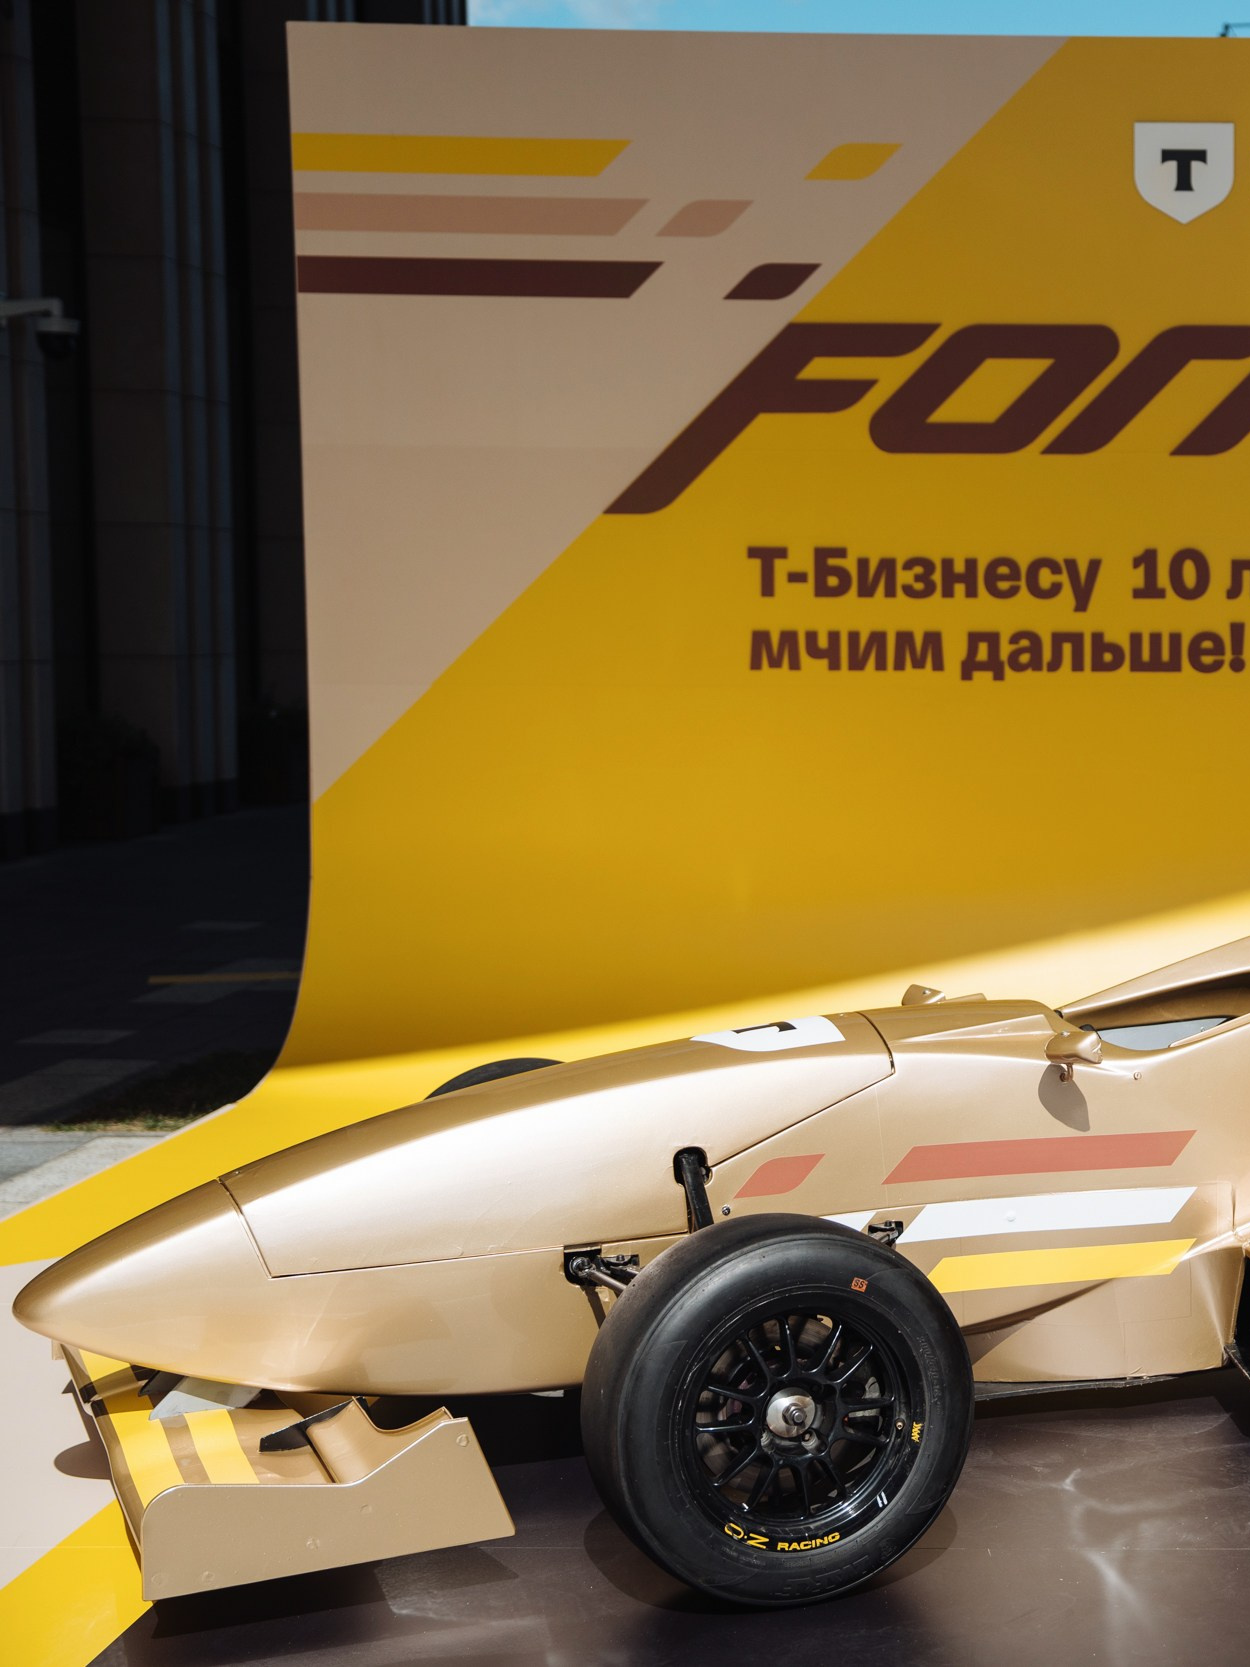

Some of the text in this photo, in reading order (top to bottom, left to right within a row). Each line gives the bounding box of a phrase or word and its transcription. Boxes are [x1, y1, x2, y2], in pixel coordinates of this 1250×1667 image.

[747, 546, 1102, 612] Т-Бизнесу
[1131, 548, 1210, 600] 10
[749, 622, 1246, 681] мчим дальше!
[777, 1531, 840, 1551] RACING
